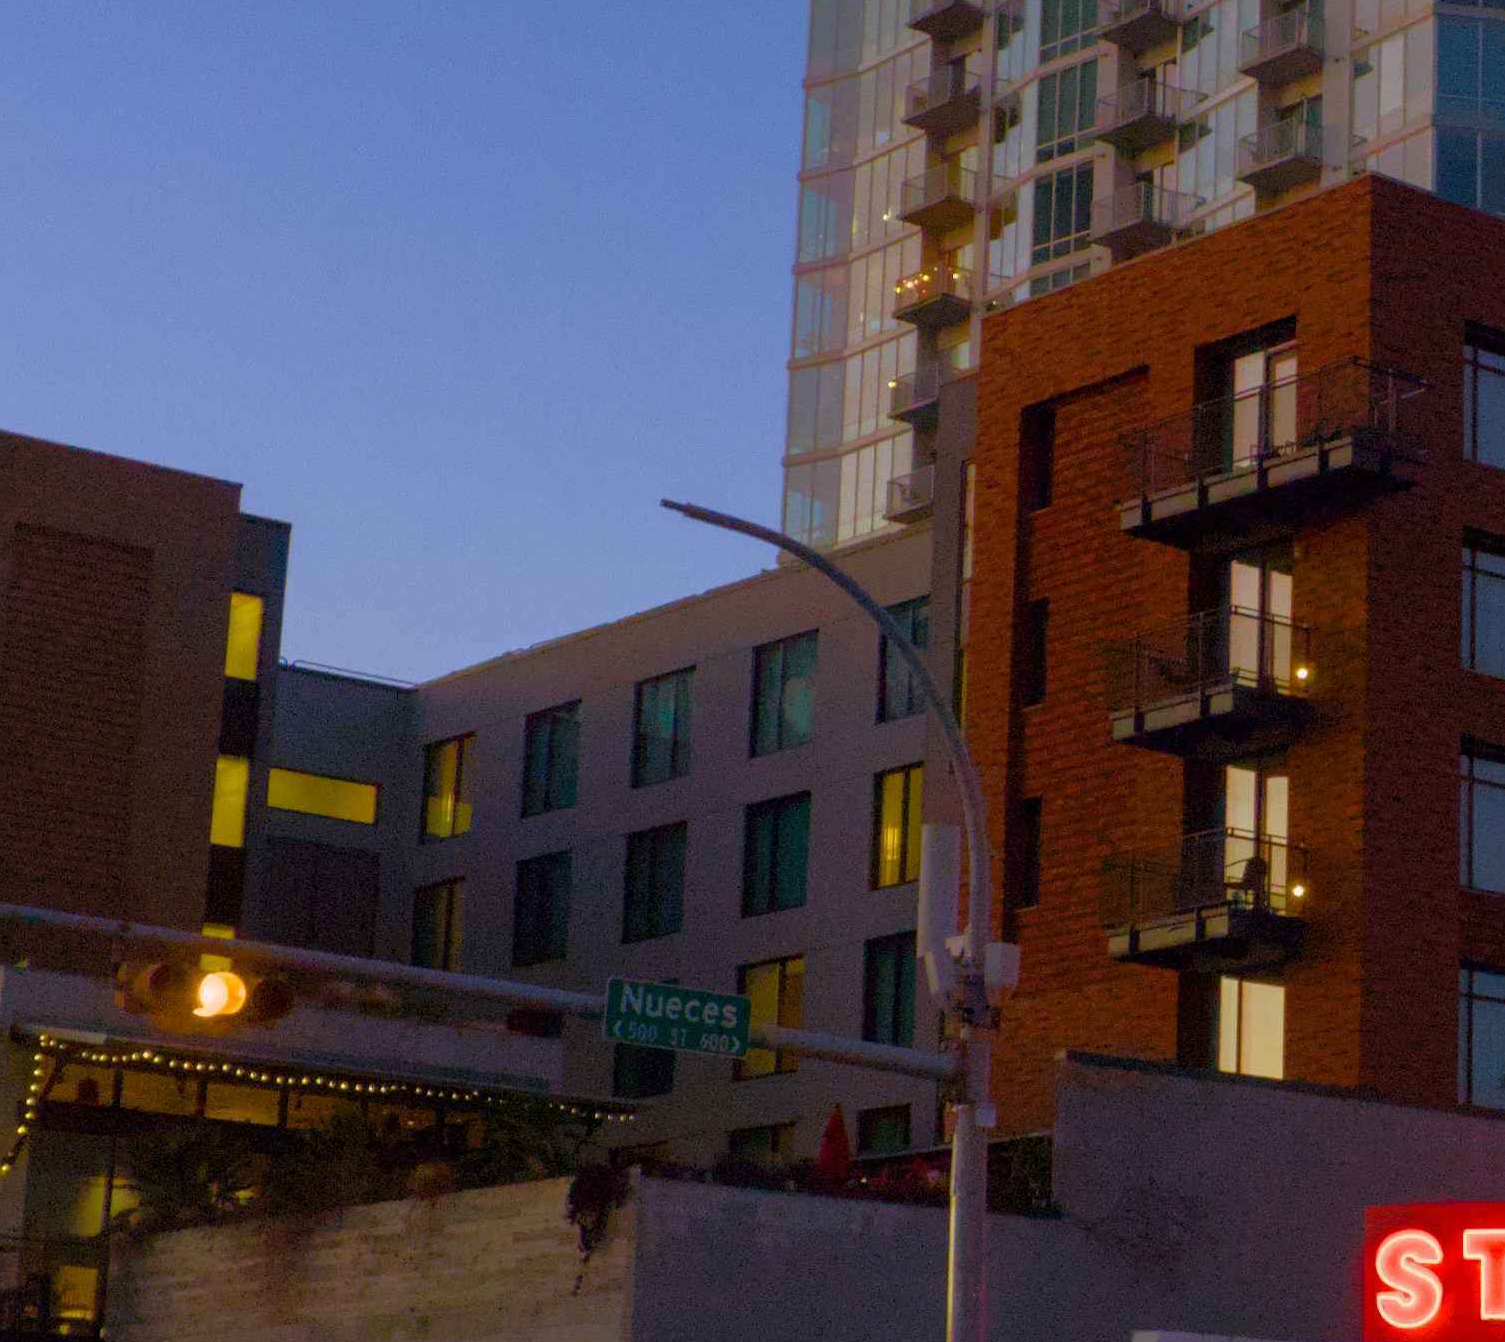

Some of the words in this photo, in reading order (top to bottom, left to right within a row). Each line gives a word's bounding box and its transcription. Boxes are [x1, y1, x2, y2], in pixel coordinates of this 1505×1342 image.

[620, 983, 738, 1029] Nueces
[628, 1021, 659, 1043] 500
[670, 1027, 689, 1047] ST
